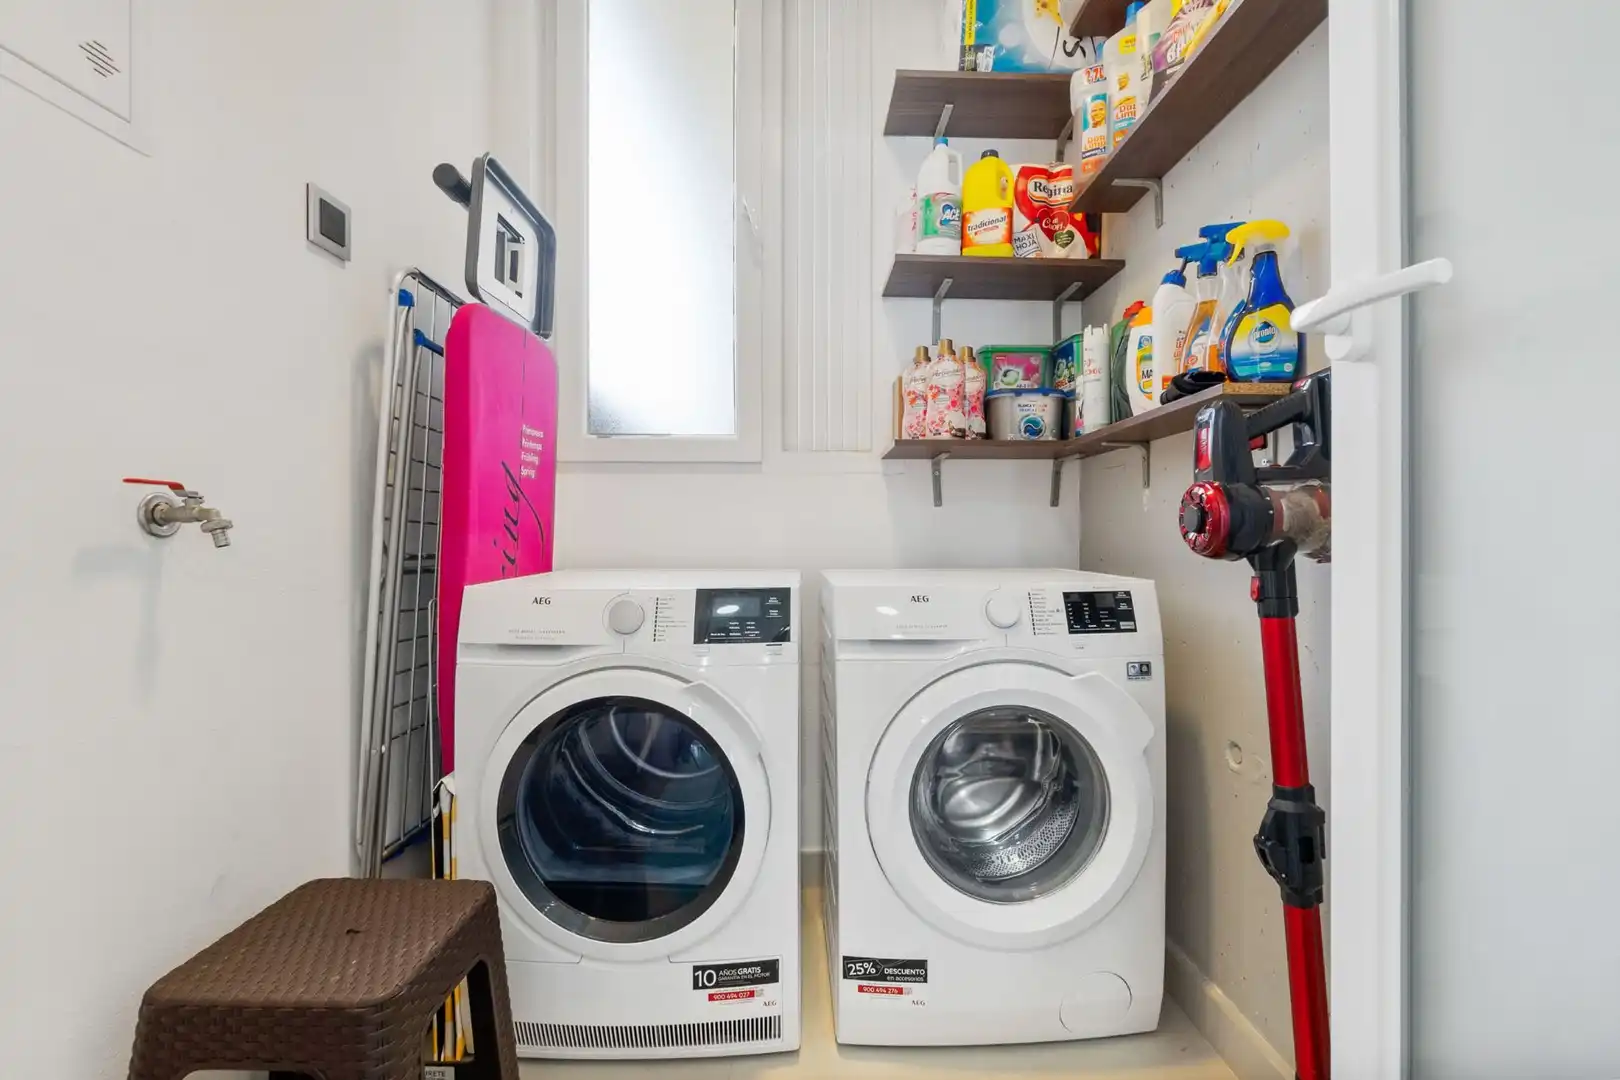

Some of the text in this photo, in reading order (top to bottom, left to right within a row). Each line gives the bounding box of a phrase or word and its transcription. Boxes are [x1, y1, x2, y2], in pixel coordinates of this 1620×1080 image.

[1033, 181, 1073, 198] Regina
[967, 215, 1007, 232] tradicional
[1013, 232, 1035, 244] MAXI
[1015, 239, 1037, 251] HOJA
[520, 466, 536, 479] Spring
[532, 596, 551, 605] AEG
[910, 595, 929, 603] AEG
[847, 961, 926, 976] 25% DESCUENTO
[694, 969, 717, 988] 10
[719, 968, 737, 976] AÑOS
[737, 967, 761, 975] GRATIS
[738, 991, 750, 999] 027
